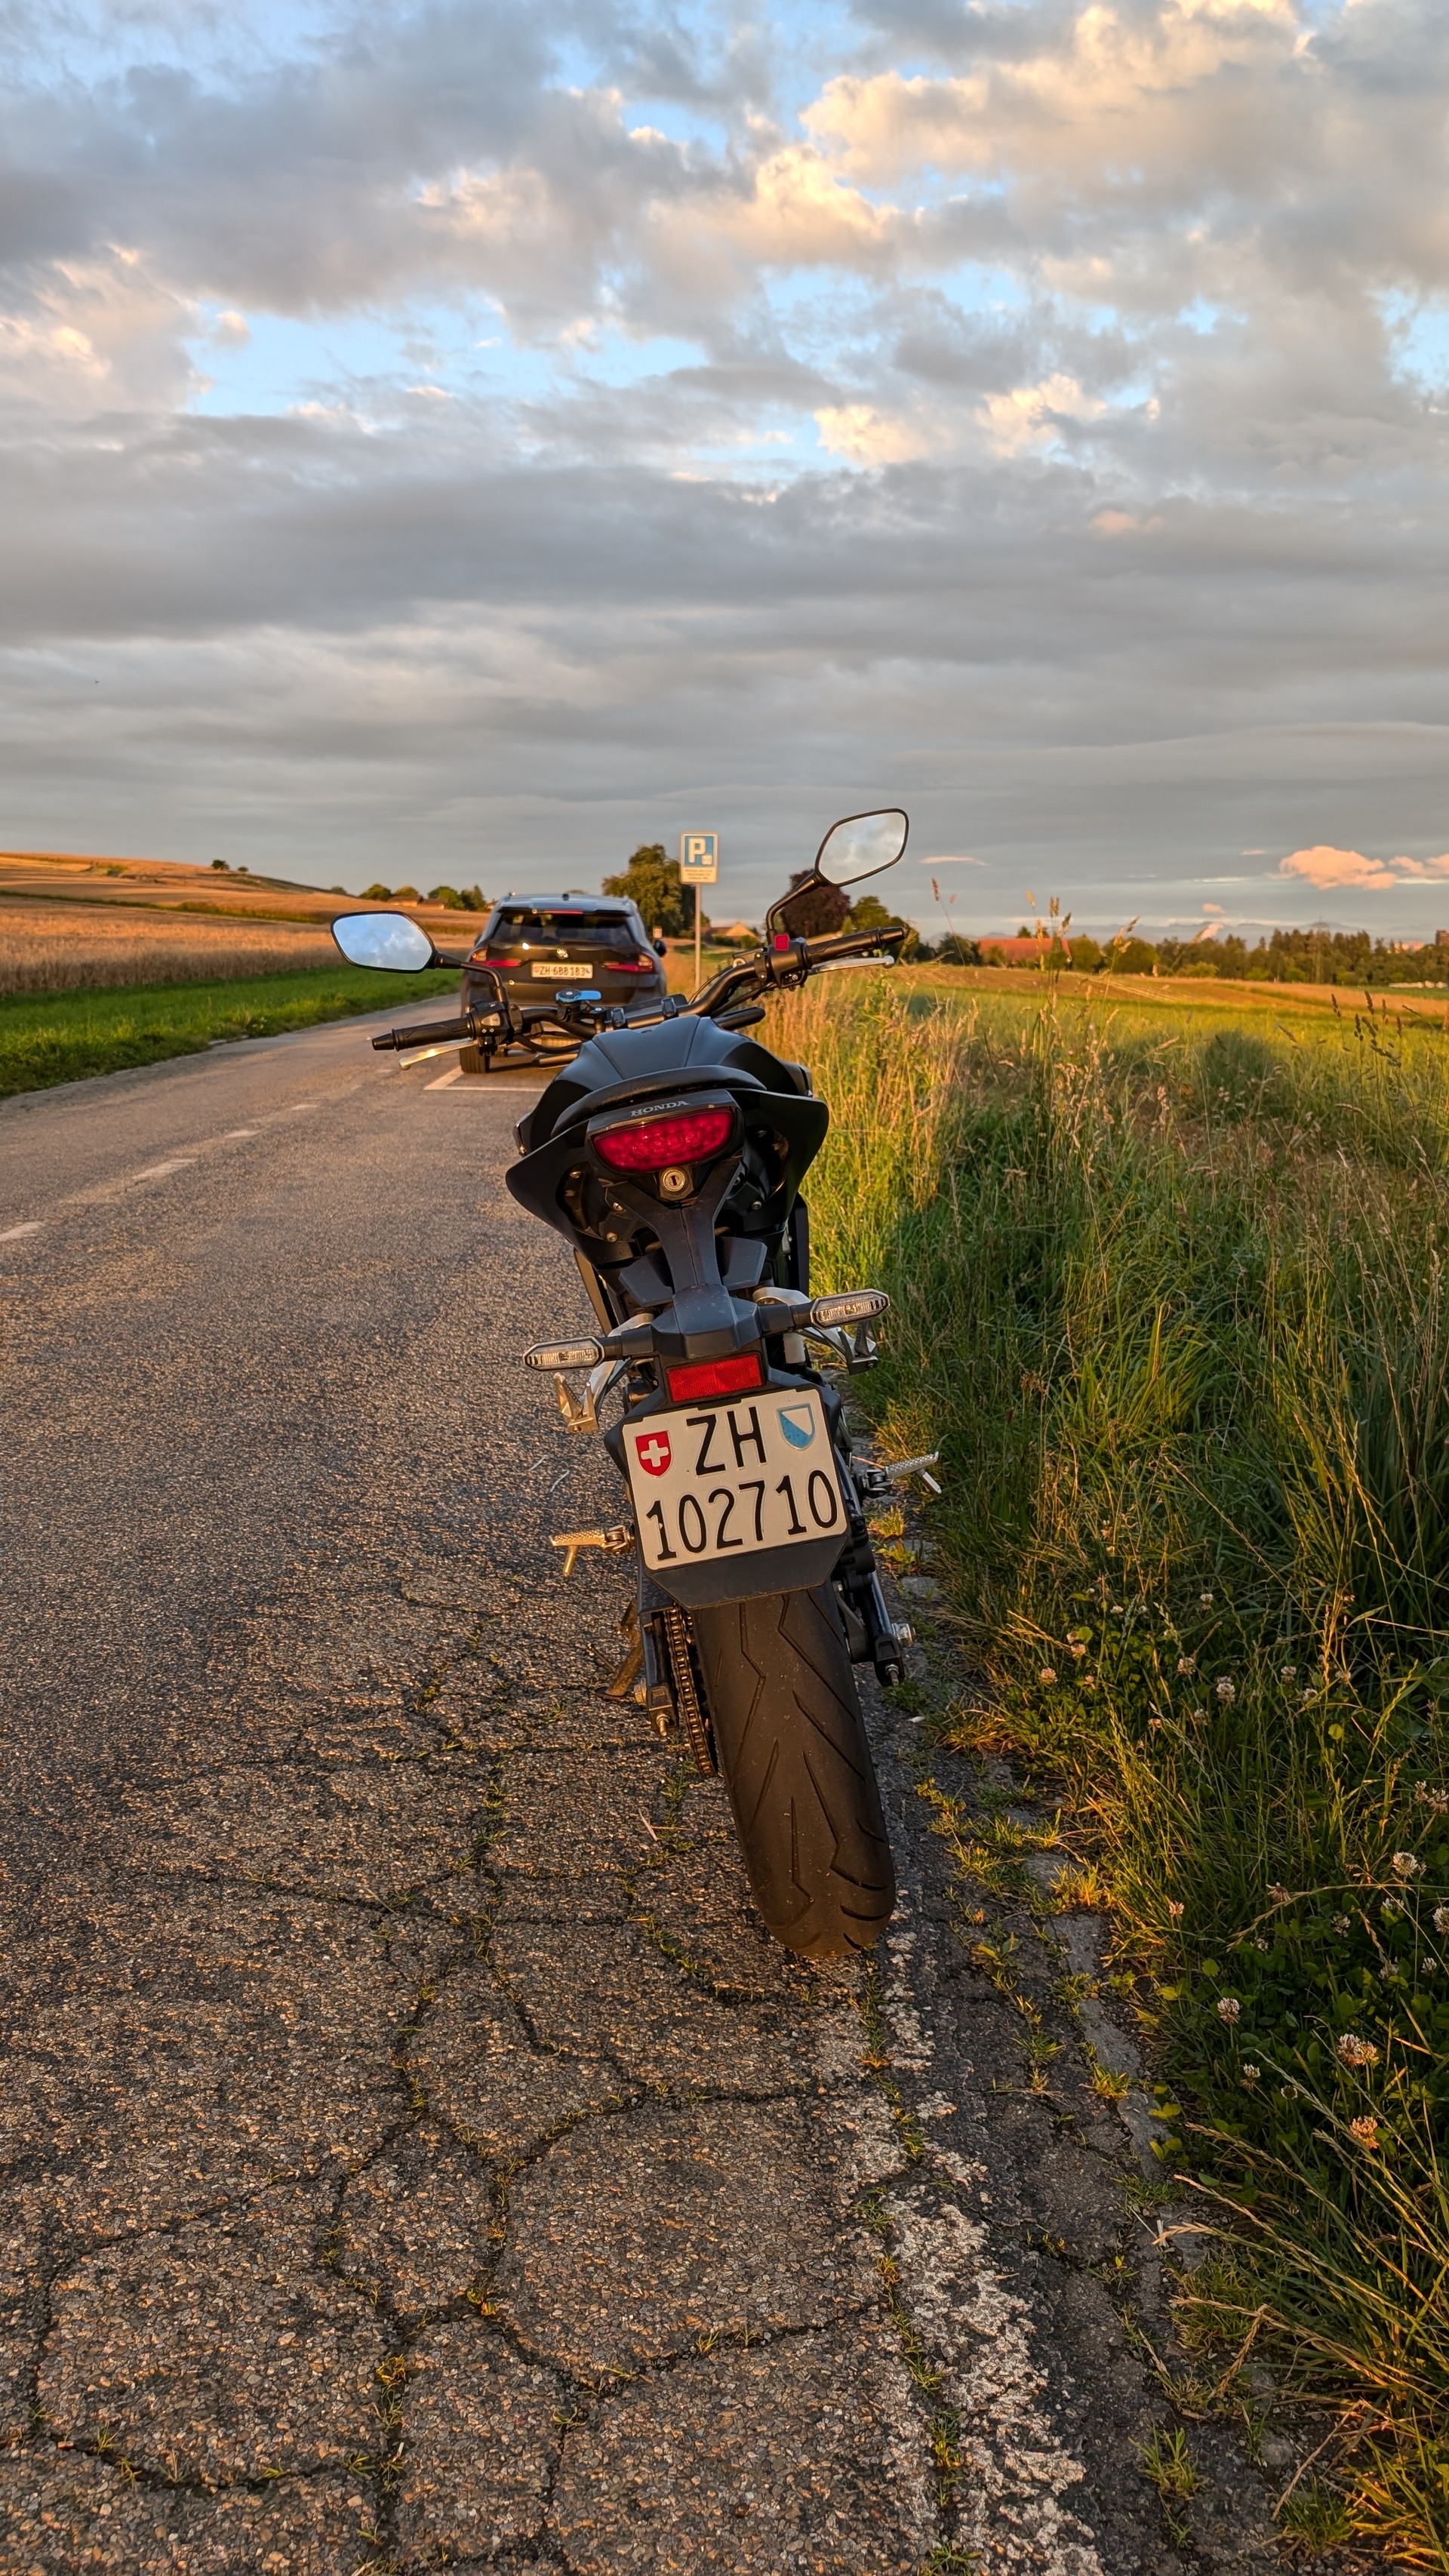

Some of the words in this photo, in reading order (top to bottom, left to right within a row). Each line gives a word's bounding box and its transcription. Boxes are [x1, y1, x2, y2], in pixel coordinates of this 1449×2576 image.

[688, 838, 706, 863] P
[631, 1100, 689, 1116] HONDA
[686, 1406, 767, 1476] ZH
[646, 1470, 838, 1561] 102710
